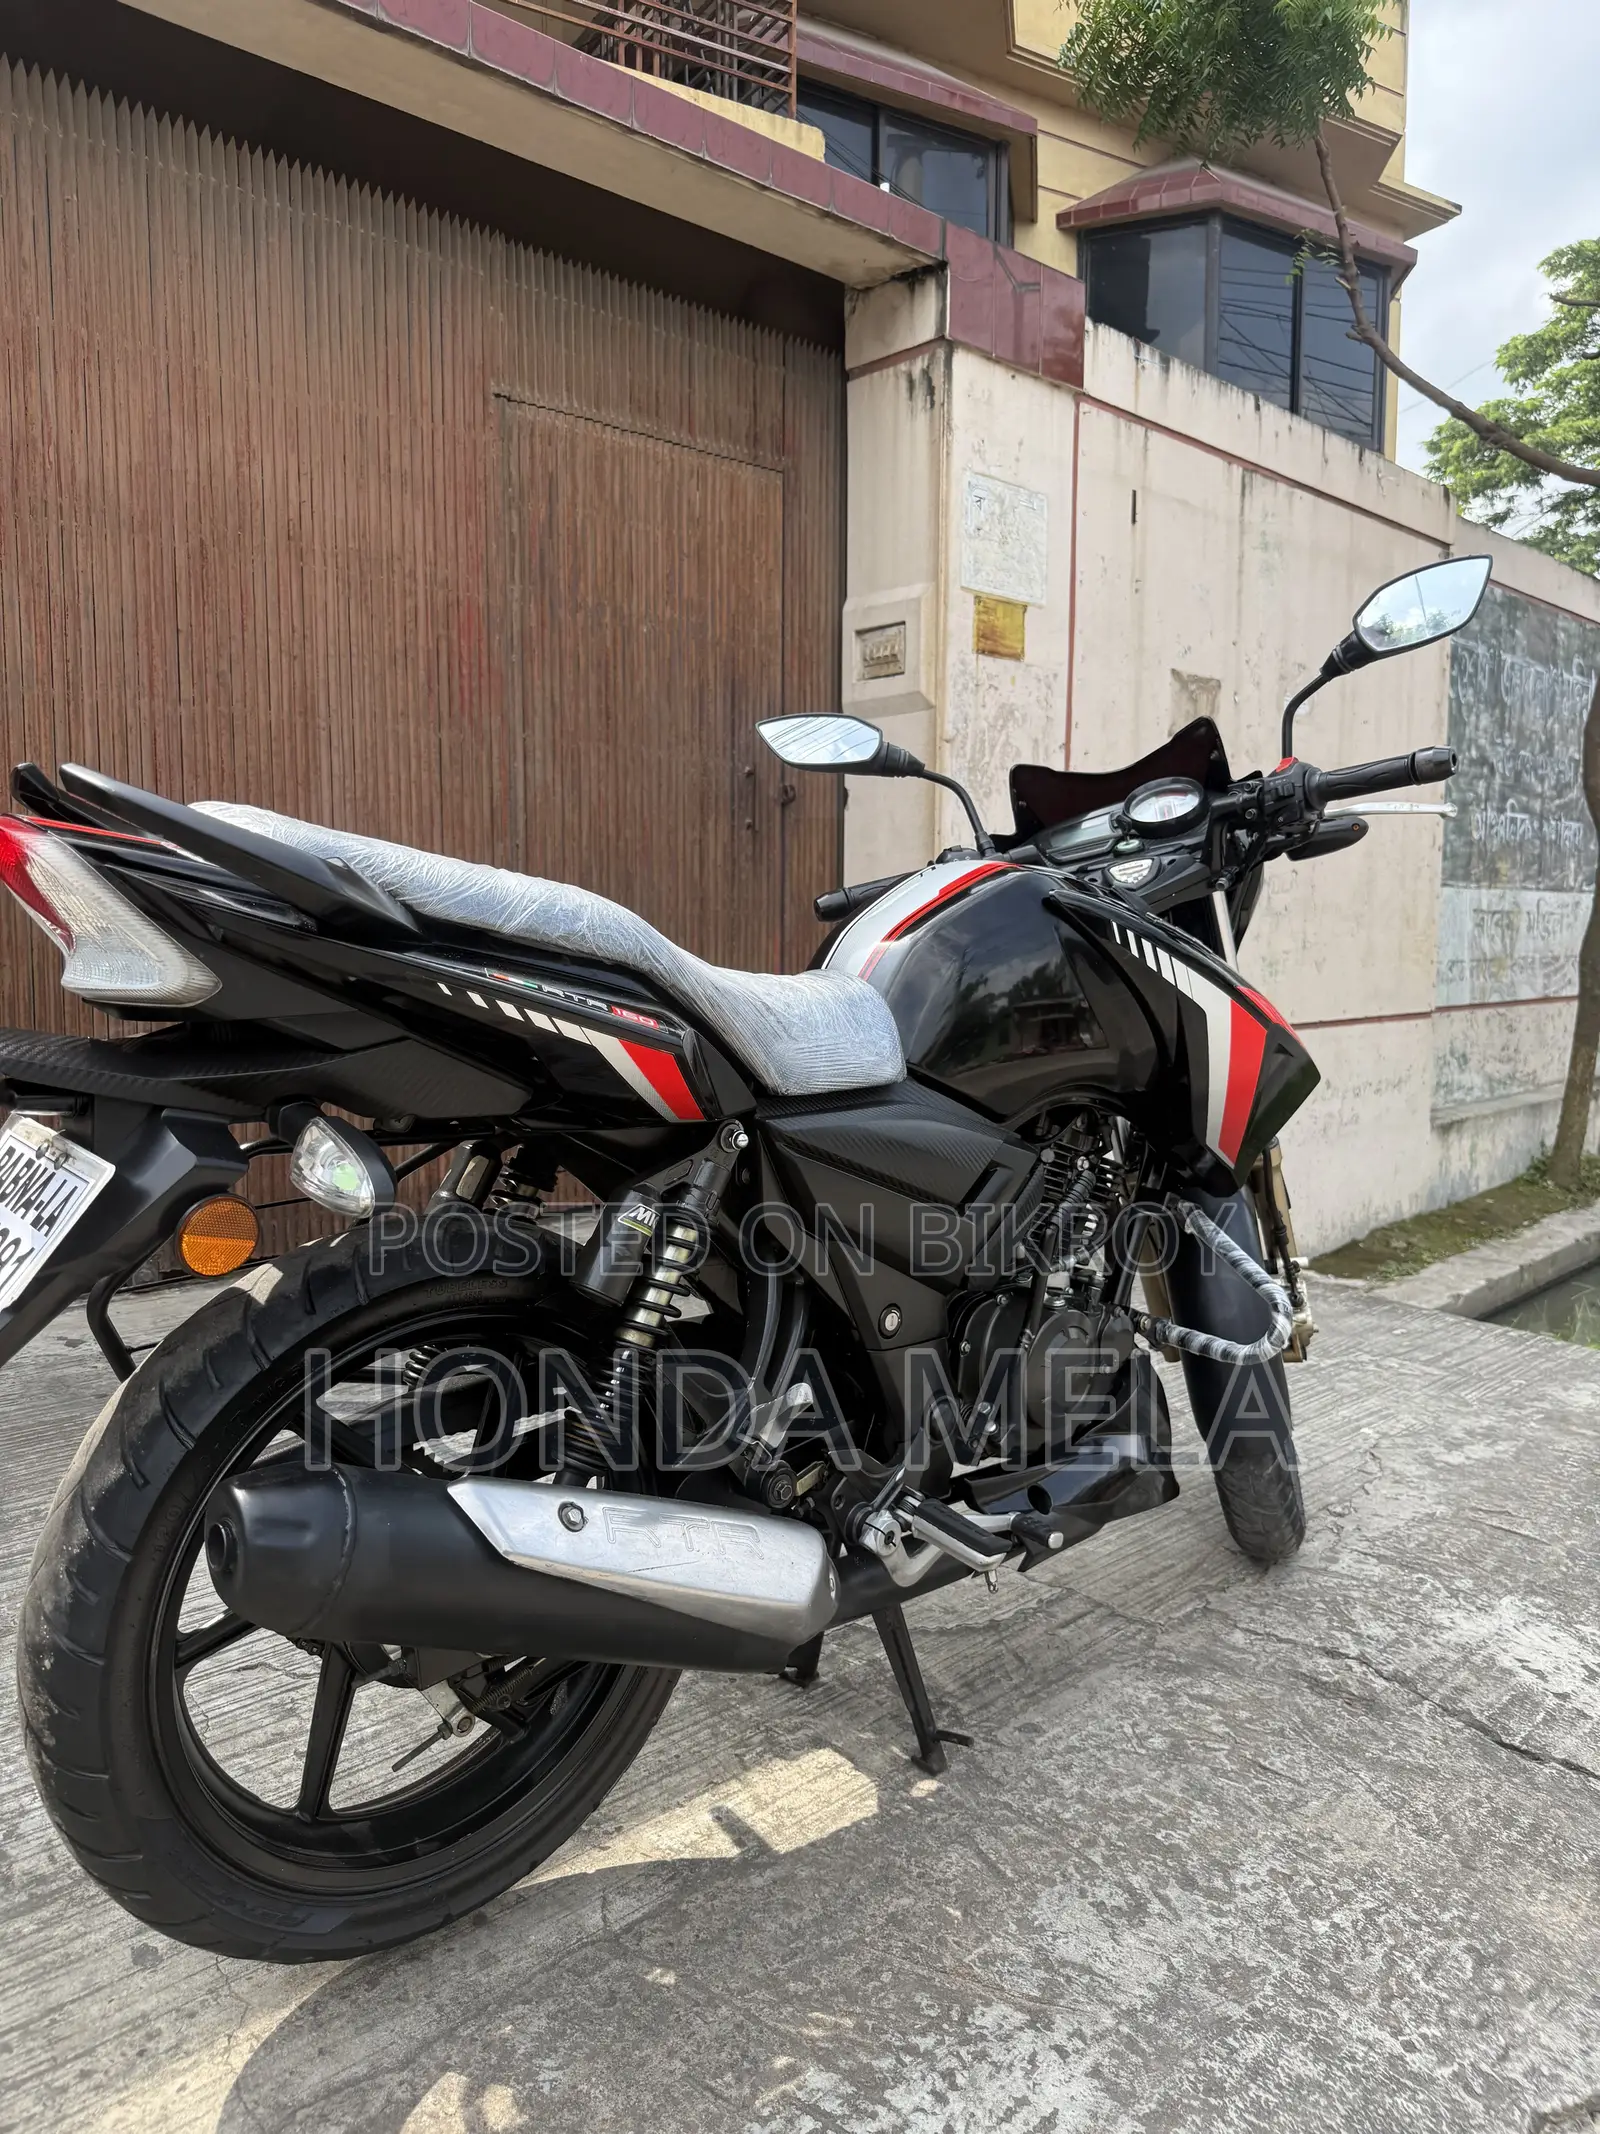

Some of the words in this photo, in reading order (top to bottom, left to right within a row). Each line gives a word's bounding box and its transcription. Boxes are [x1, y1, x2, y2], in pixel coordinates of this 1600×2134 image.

[541, 984, 609, 1012] RTR
[423, 1279, 508, 1299] TUBELESS
[602, 1506, 765, 1560] RTR
